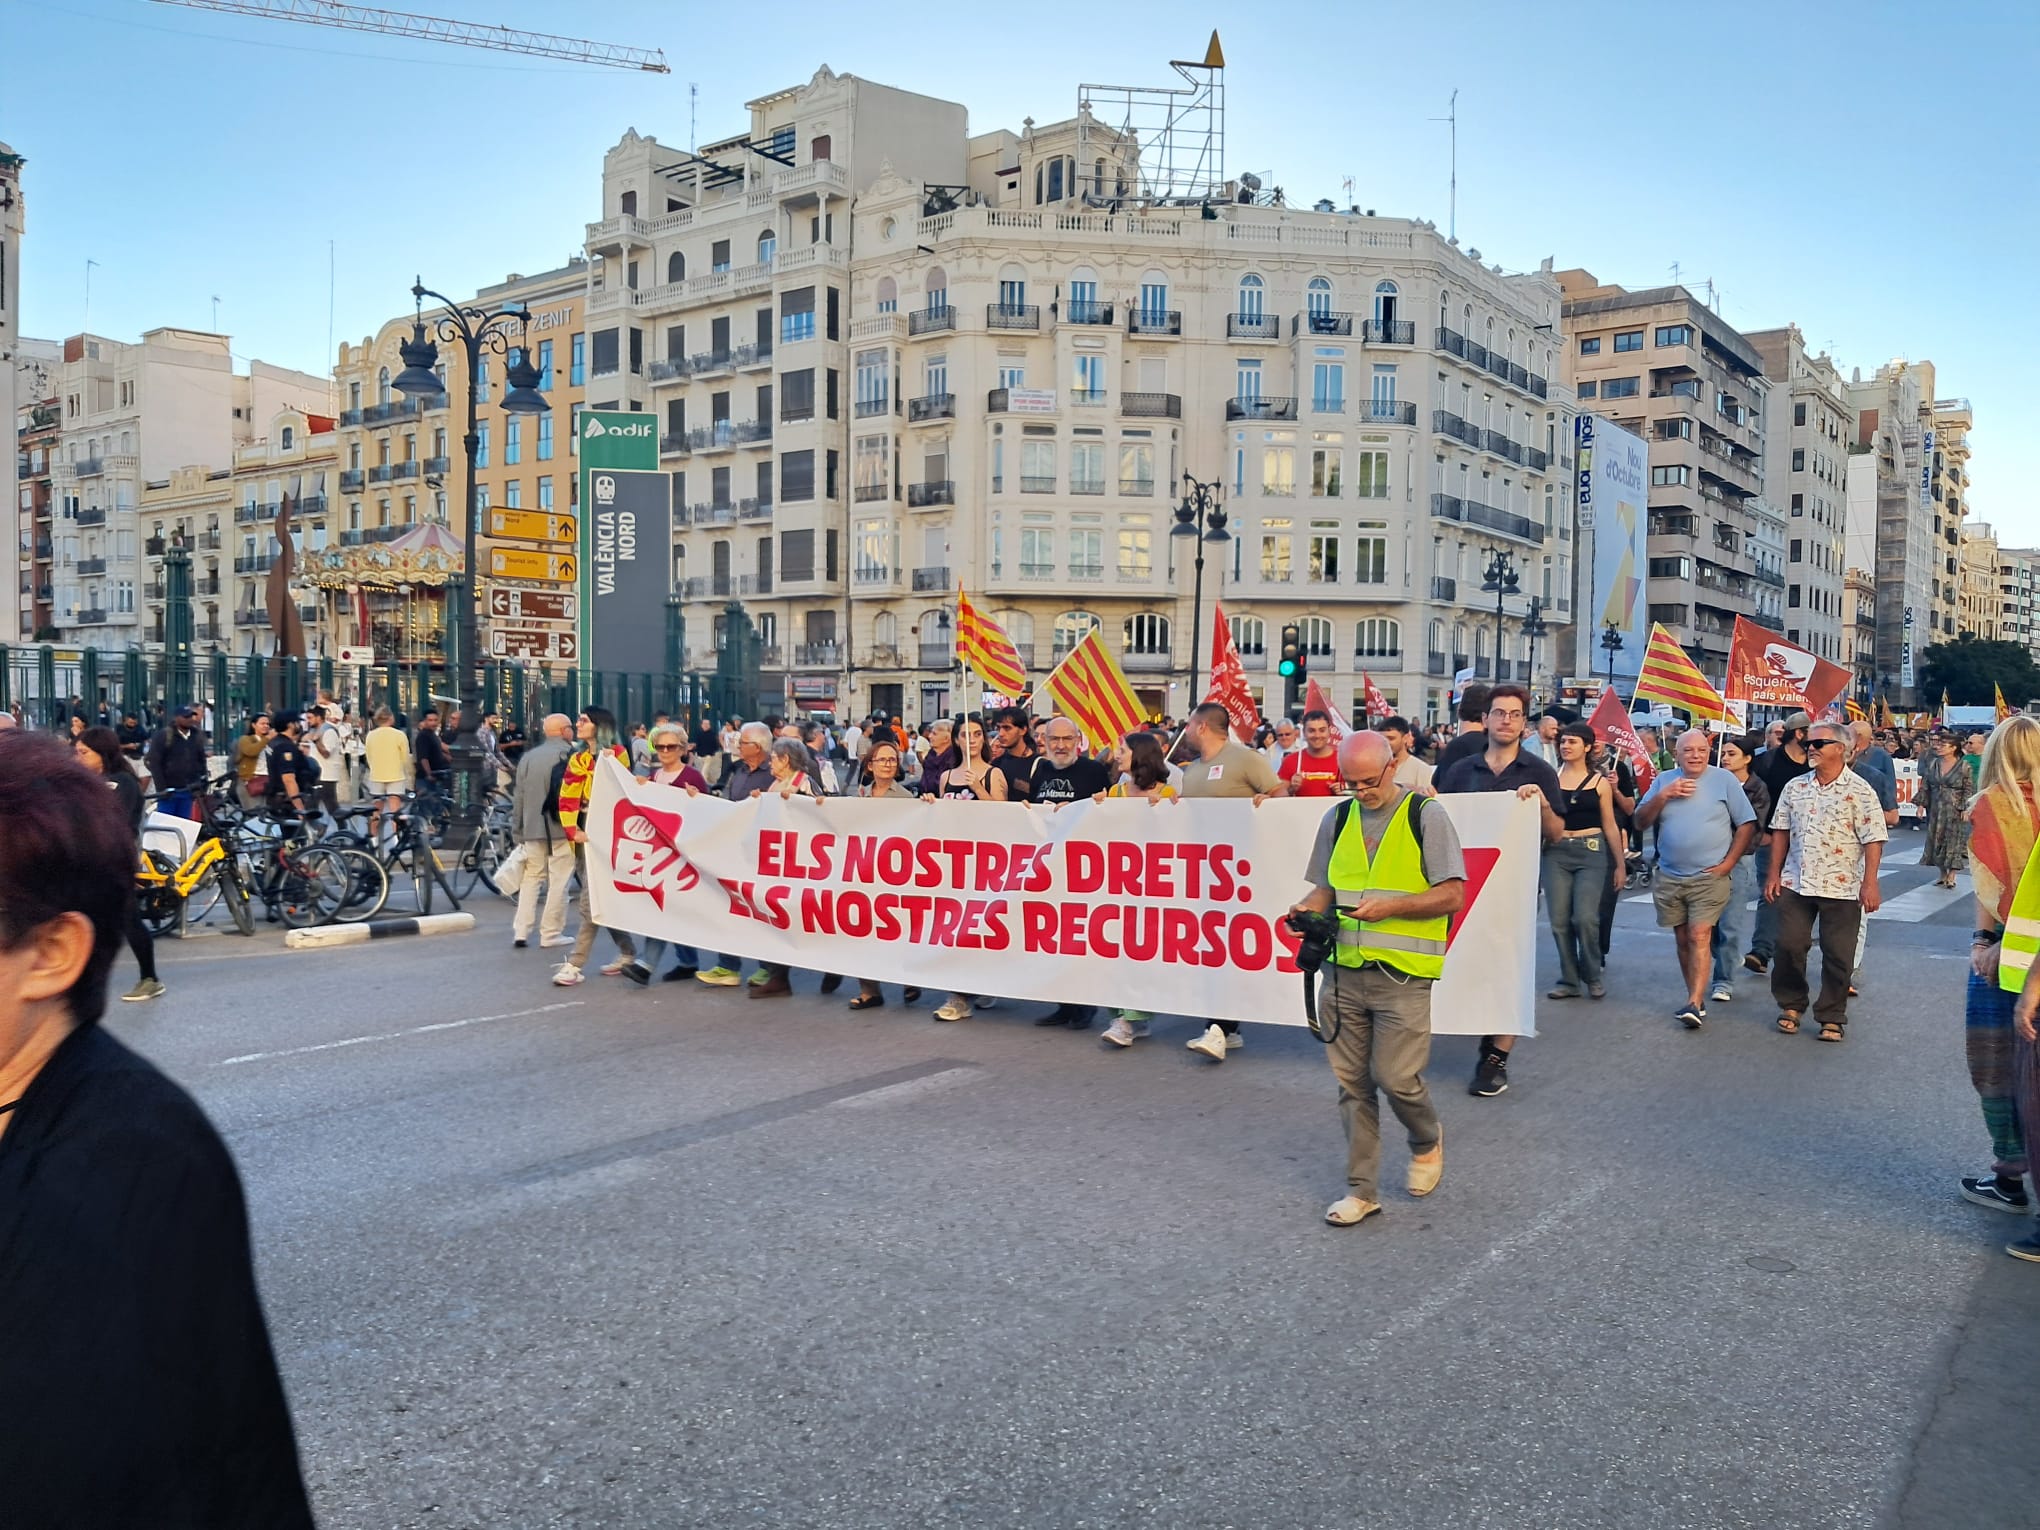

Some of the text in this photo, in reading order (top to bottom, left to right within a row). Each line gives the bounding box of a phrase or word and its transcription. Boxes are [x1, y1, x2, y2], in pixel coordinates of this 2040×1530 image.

[532, 306, 573, 332] ZENIT
[608, 423, 653, 437] adif
[594, 512, 615, 596] VALÈNCIA
[618, 511, 636, 560] NORD
[1753, 690, 1812, 703] país valen
[757, 829, 1252, 903] ELS NOSTRES DRETS:
[719, 879, 1304, 973] ELS NOSTRES RECURSOS
